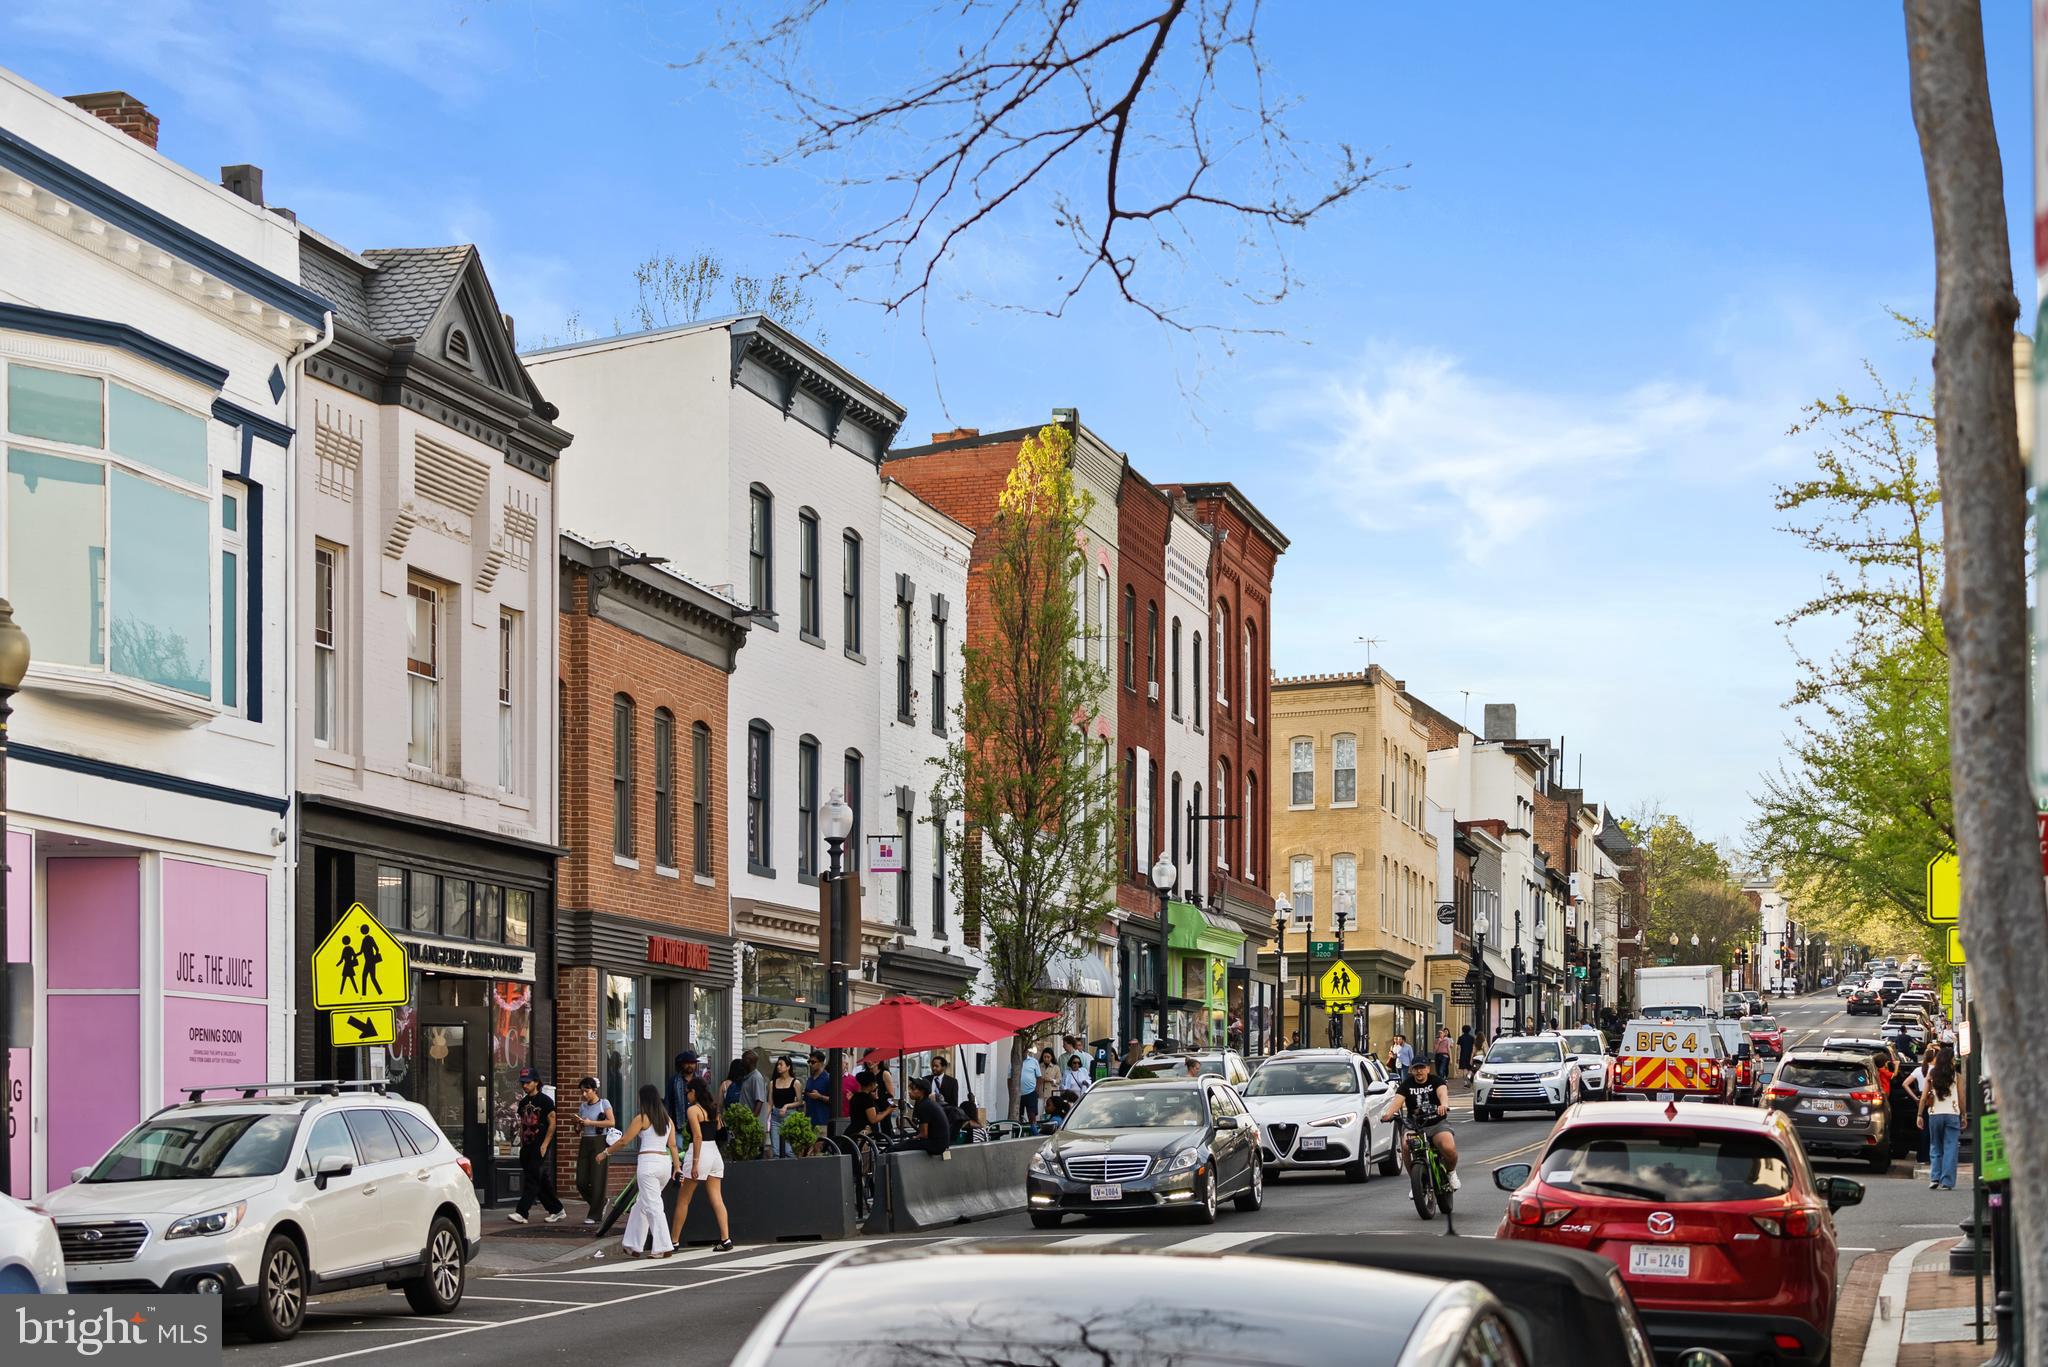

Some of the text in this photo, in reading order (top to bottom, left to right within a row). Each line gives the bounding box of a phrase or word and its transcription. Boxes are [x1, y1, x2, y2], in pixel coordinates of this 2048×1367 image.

[664, 938, 686, 967] STREET
[1316, 943, 1323, 951] P
[177, 951, 195, 982] JOE
[205, 954, 223, 985] THE
[226, 957, 253, 988] JUICE
[189, 1027, 242, 1043] OPENING SOON
[1636, 1031, 1697, 1053] BFC 4
[1098, 1048, 1106, 1059] P
[1409, 1084, 1433, 1095] TUPAC
[1559, 1224, 1592, 1233] CX-5
[1635, 1252, 1684, 1268] JT 1246
